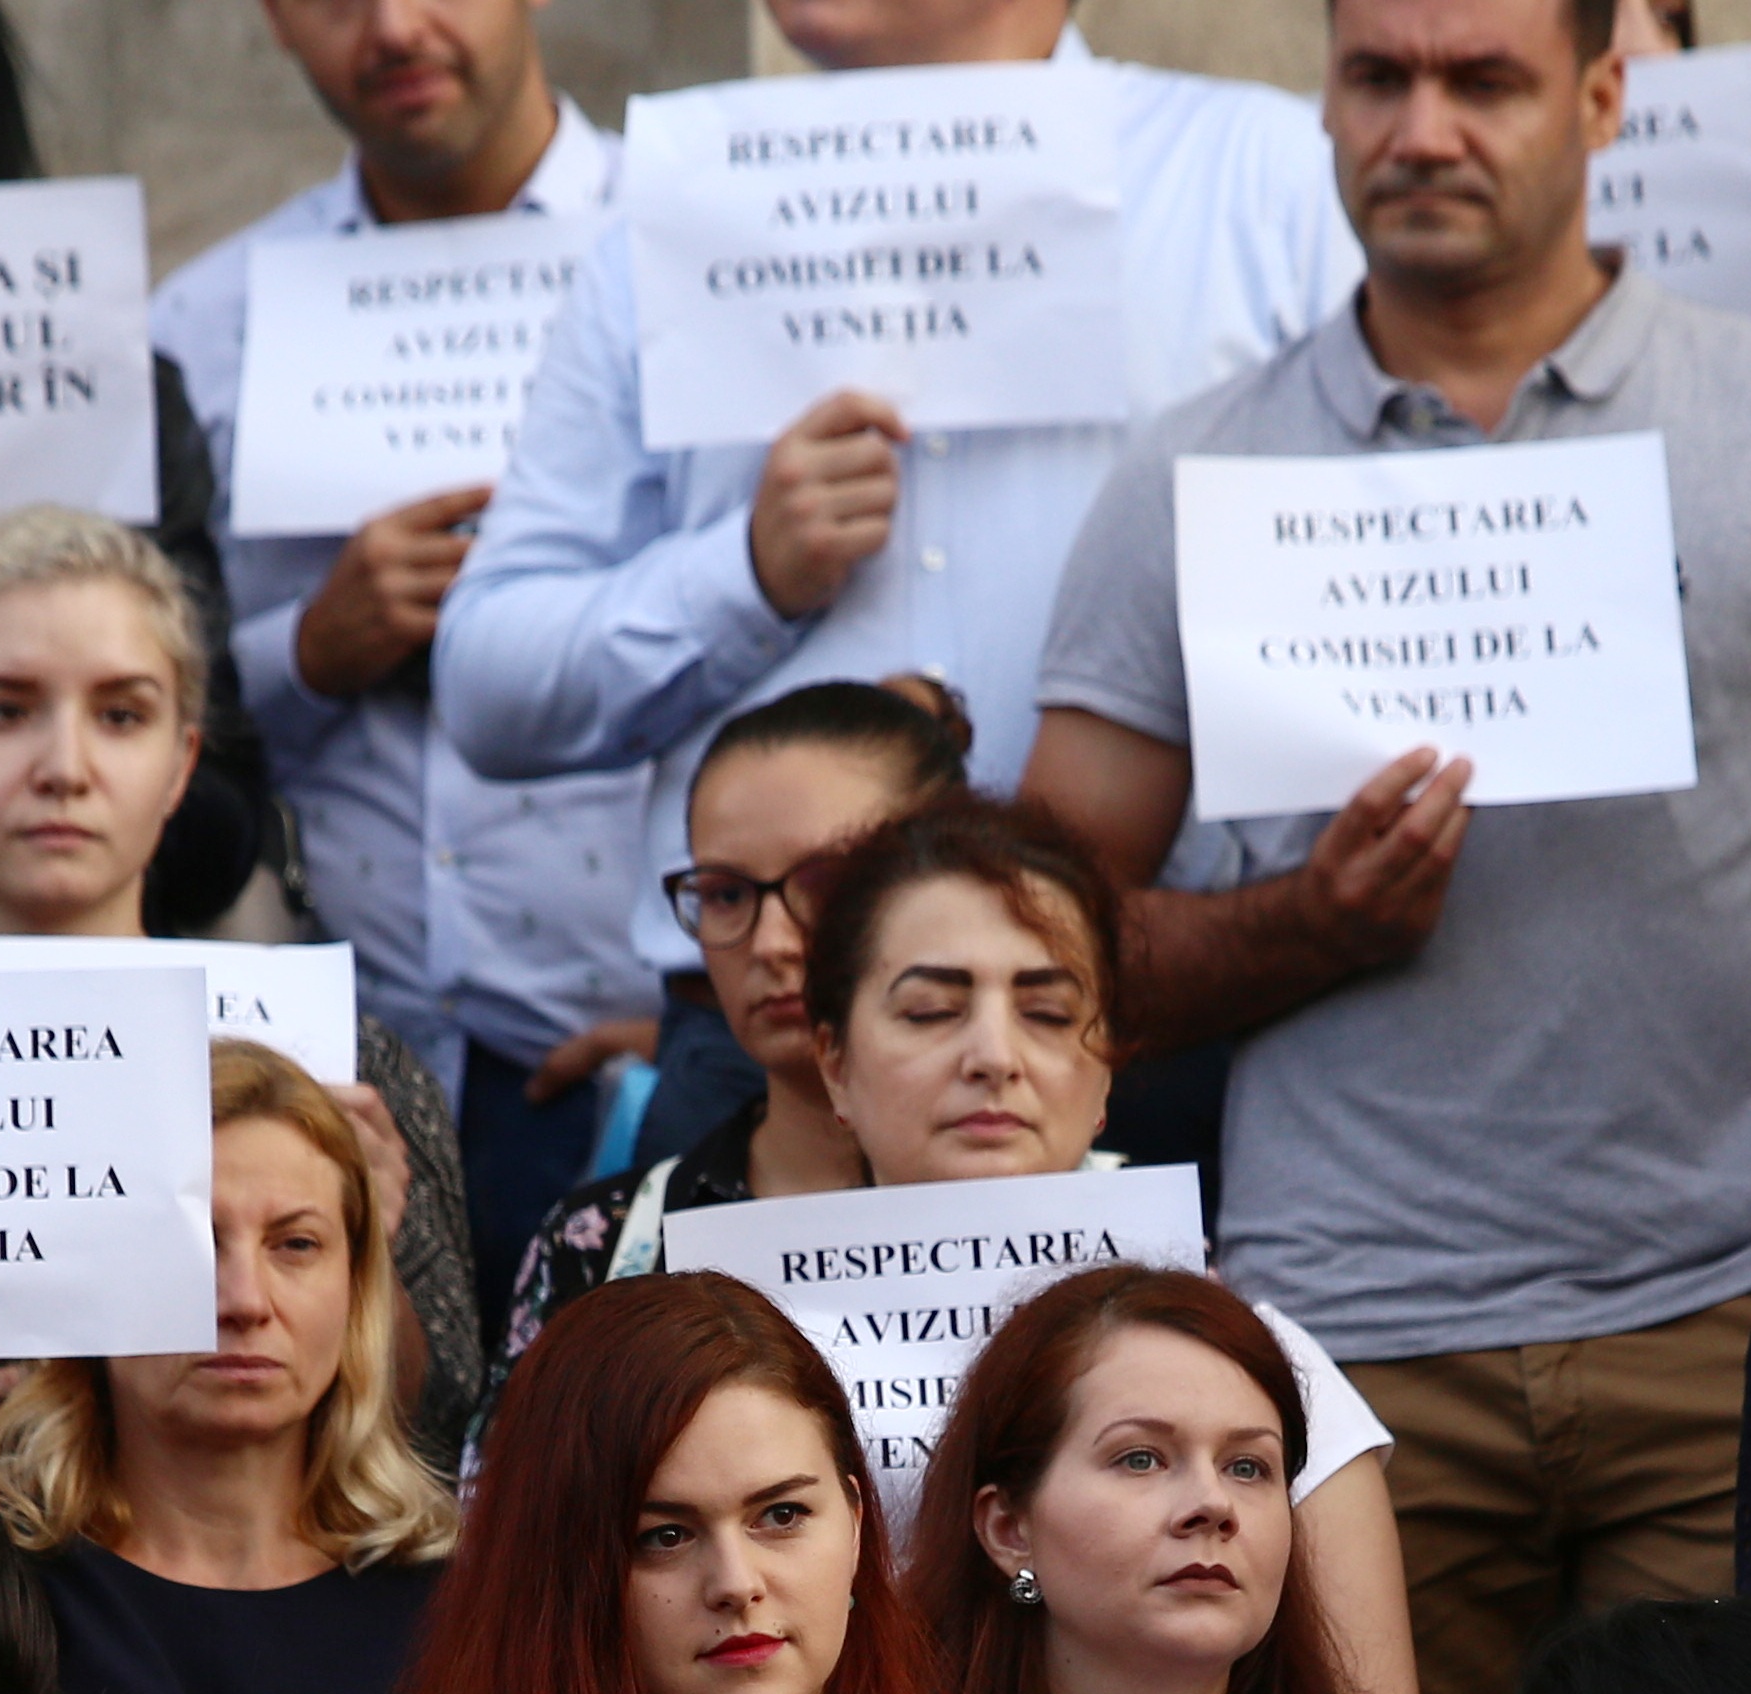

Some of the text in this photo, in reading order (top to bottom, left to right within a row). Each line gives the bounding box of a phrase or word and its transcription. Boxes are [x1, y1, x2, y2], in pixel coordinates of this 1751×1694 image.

[727, 117, 1039, 169] RESPECTAREA
[771, 180, 979, 228] AVIZULUI
[34, 249, 82, 299] ȘI
[705, 242, 1043, 297] COMISIEI DE LA
[782, 309, 970, 346] VENEȚIA
[40, 366, 97, 411] ÎN
[1274, 497, 1589, 545] RESPECTAREA
[1319, 562, 1530, 607] AVIZULUI
[1260, 624, 1600, 668] COMISIEI DE LA
[1343, 686, 1527, 725] VENEȚIA
[67, 1165, 126, 1198] LA
[781, 1229, 1119, 1284] RESPECTAREA
